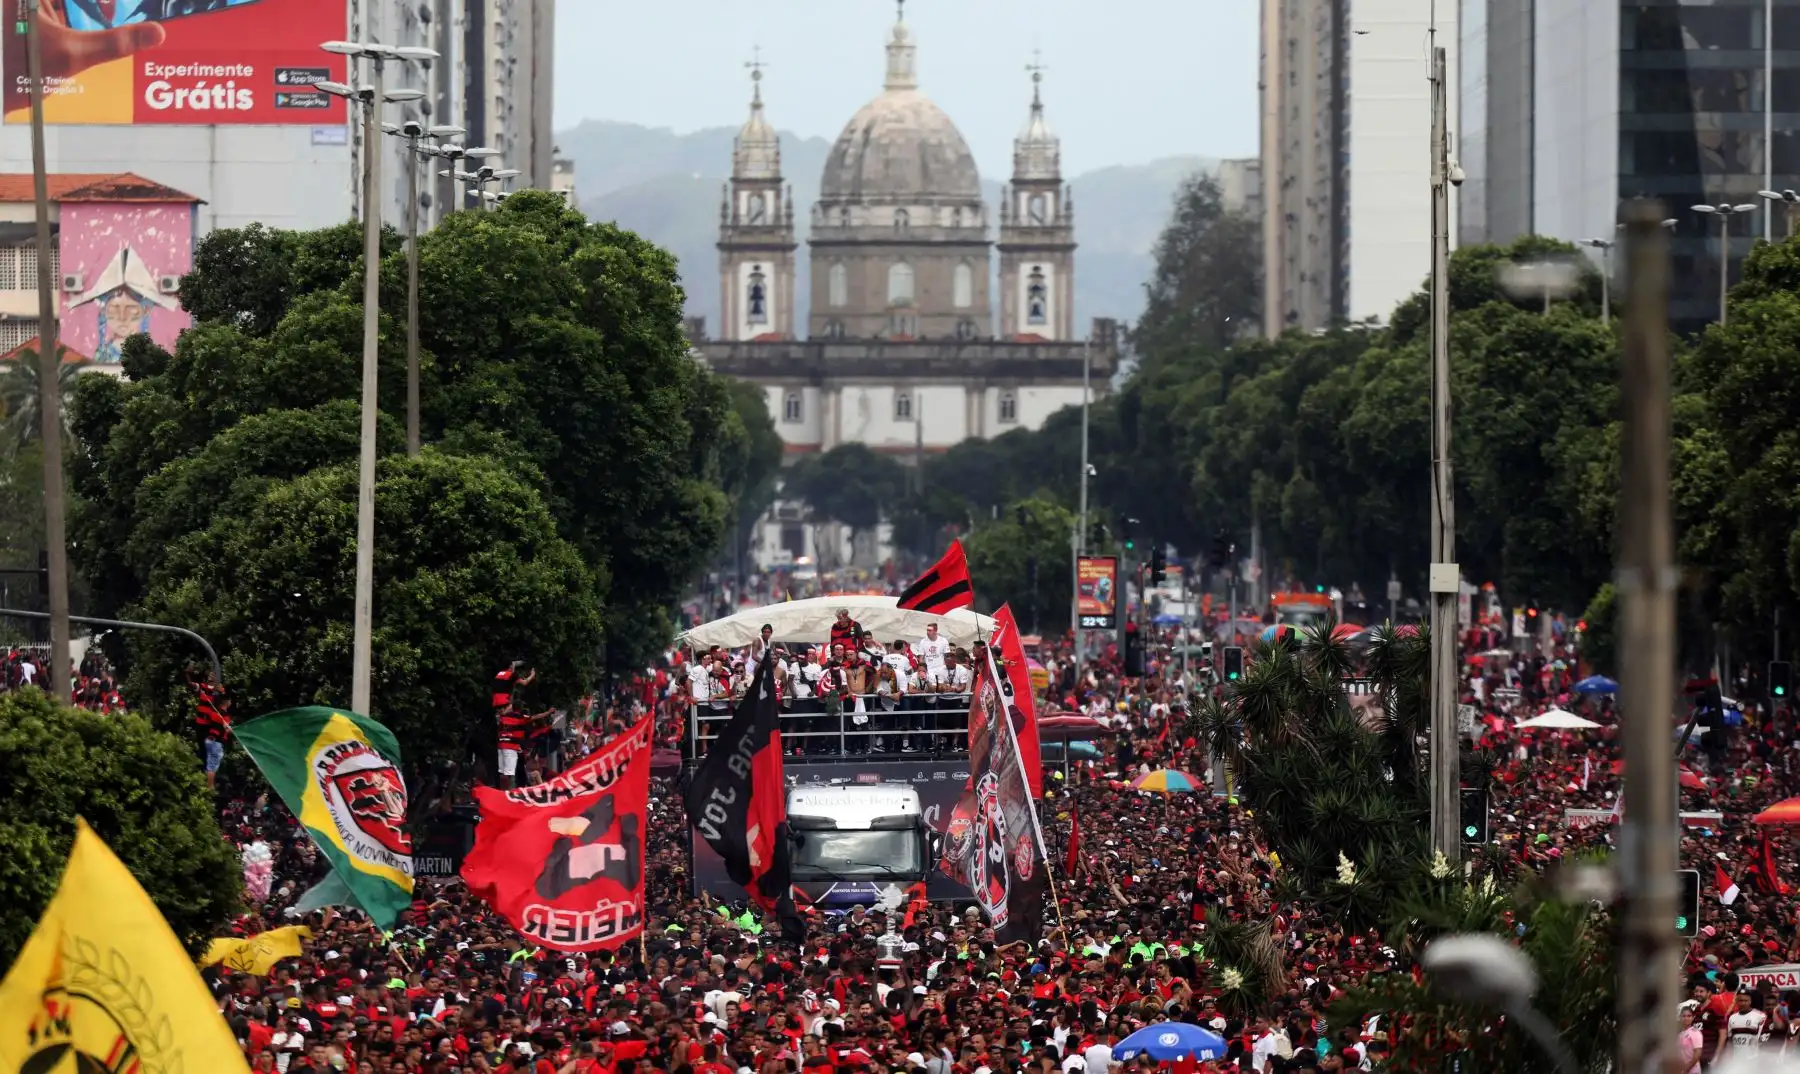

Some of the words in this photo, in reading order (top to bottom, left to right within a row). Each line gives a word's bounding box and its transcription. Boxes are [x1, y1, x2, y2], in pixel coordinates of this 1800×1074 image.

[144, 61, 253, 79] Experimente
[144, 80, 254, 110] Grátis
[413, 857, 453, 874] MARTIN
